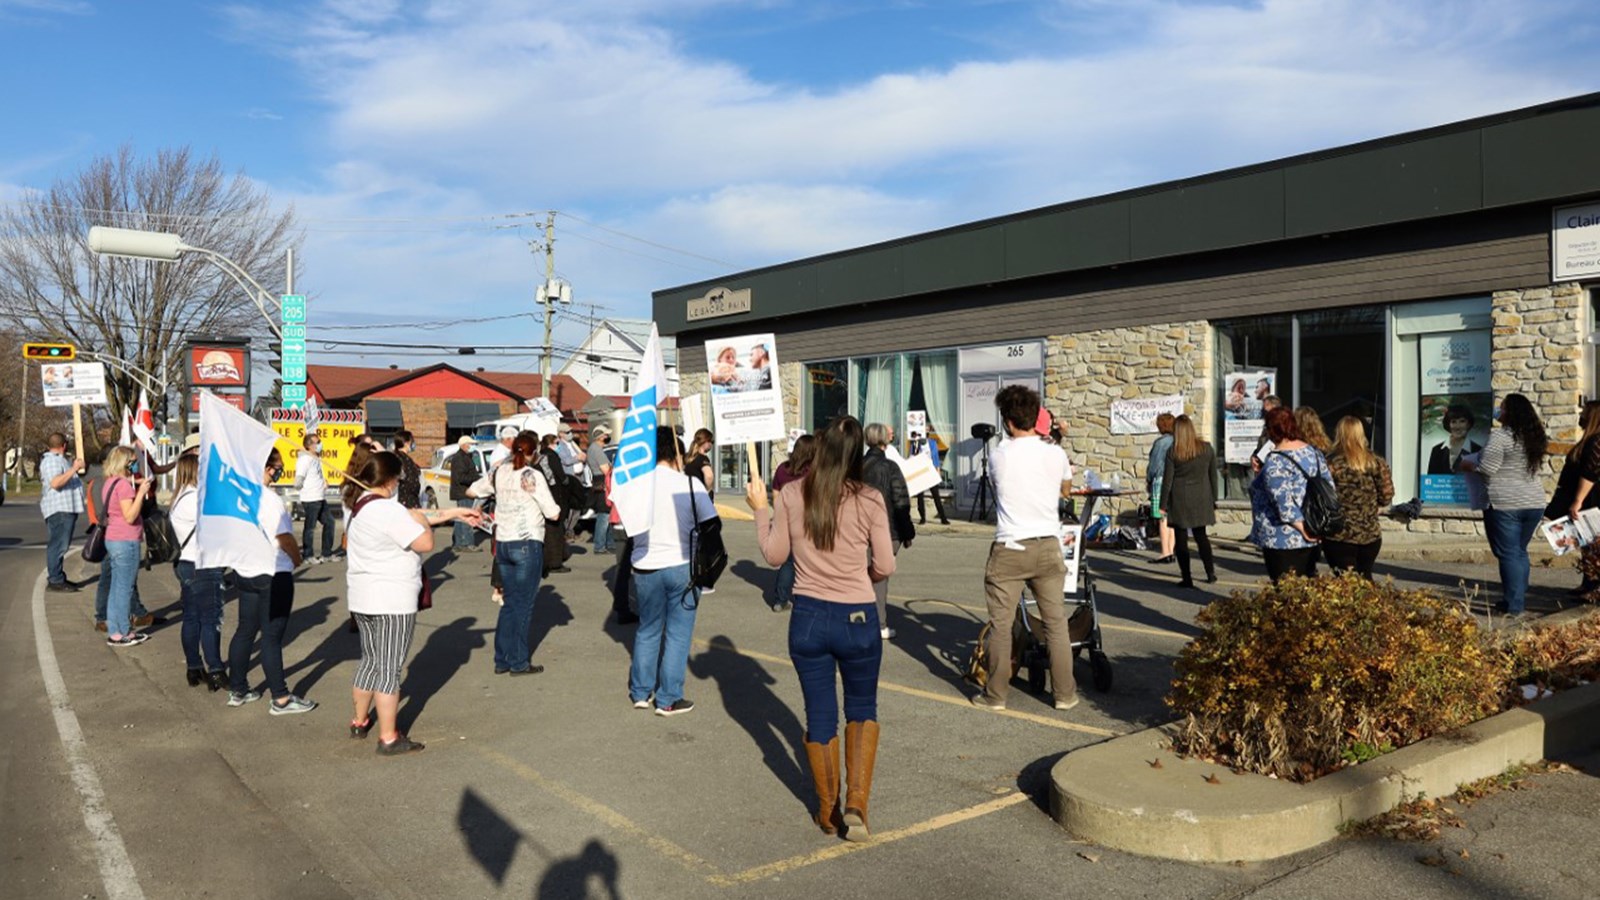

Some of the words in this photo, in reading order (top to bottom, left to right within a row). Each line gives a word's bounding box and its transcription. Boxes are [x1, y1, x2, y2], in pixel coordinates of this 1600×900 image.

[1565, 260, 1595, 269] Bureau
[284, 307, 303, 319] 205
[283, 327, 304, 337] SUD
[1007, 345, 1025, 357] 265
[284, 367, 303, 378] 138
[284, 387, 303, 397] EST
[278, 427, 291, 438] LE
[297, 427, 329, 438] SRE
[333, 428, 355, 439] PAIN
